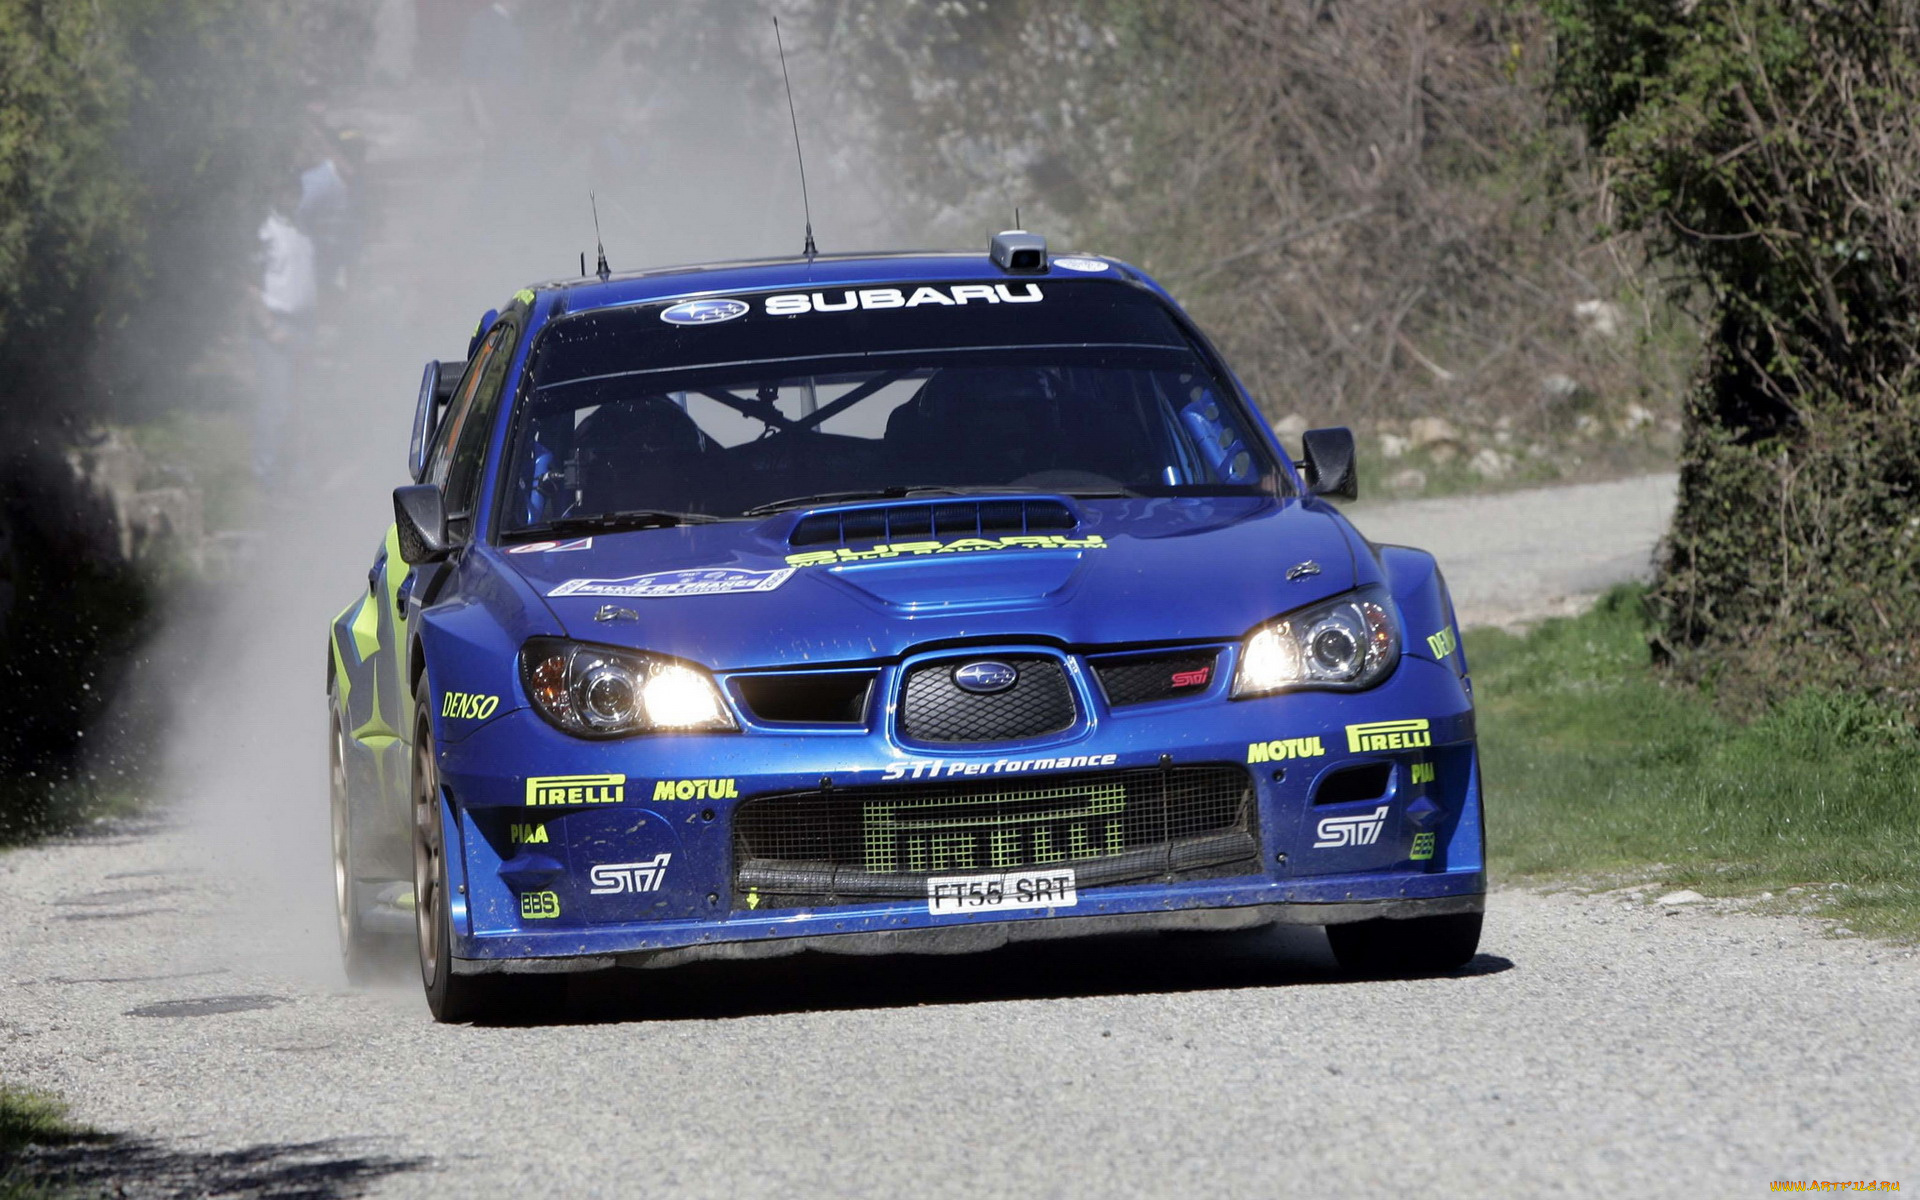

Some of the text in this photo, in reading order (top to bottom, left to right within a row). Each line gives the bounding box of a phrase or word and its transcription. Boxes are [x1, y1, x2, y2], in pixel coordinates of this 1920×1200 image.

[765, 283, 1043, 316] SUBARU
[785, 535, 1104, 564] SUBARU
[441, 691, 500, 720] DENSO
[1247, 736, 1325, 764] MOTUL
[1345, 718, 1432, 754] PIRELLI
[882, 753, 1117, 780] STI Performance
[526, 773, 626, 806] PIRELLI
[652, 778, 739, 801] MOTUL
[510, 824, 550, 844] PIAA
[521, 891, 561, 919] BBS
[934, 876, 1070, 909] FT55 SRT
